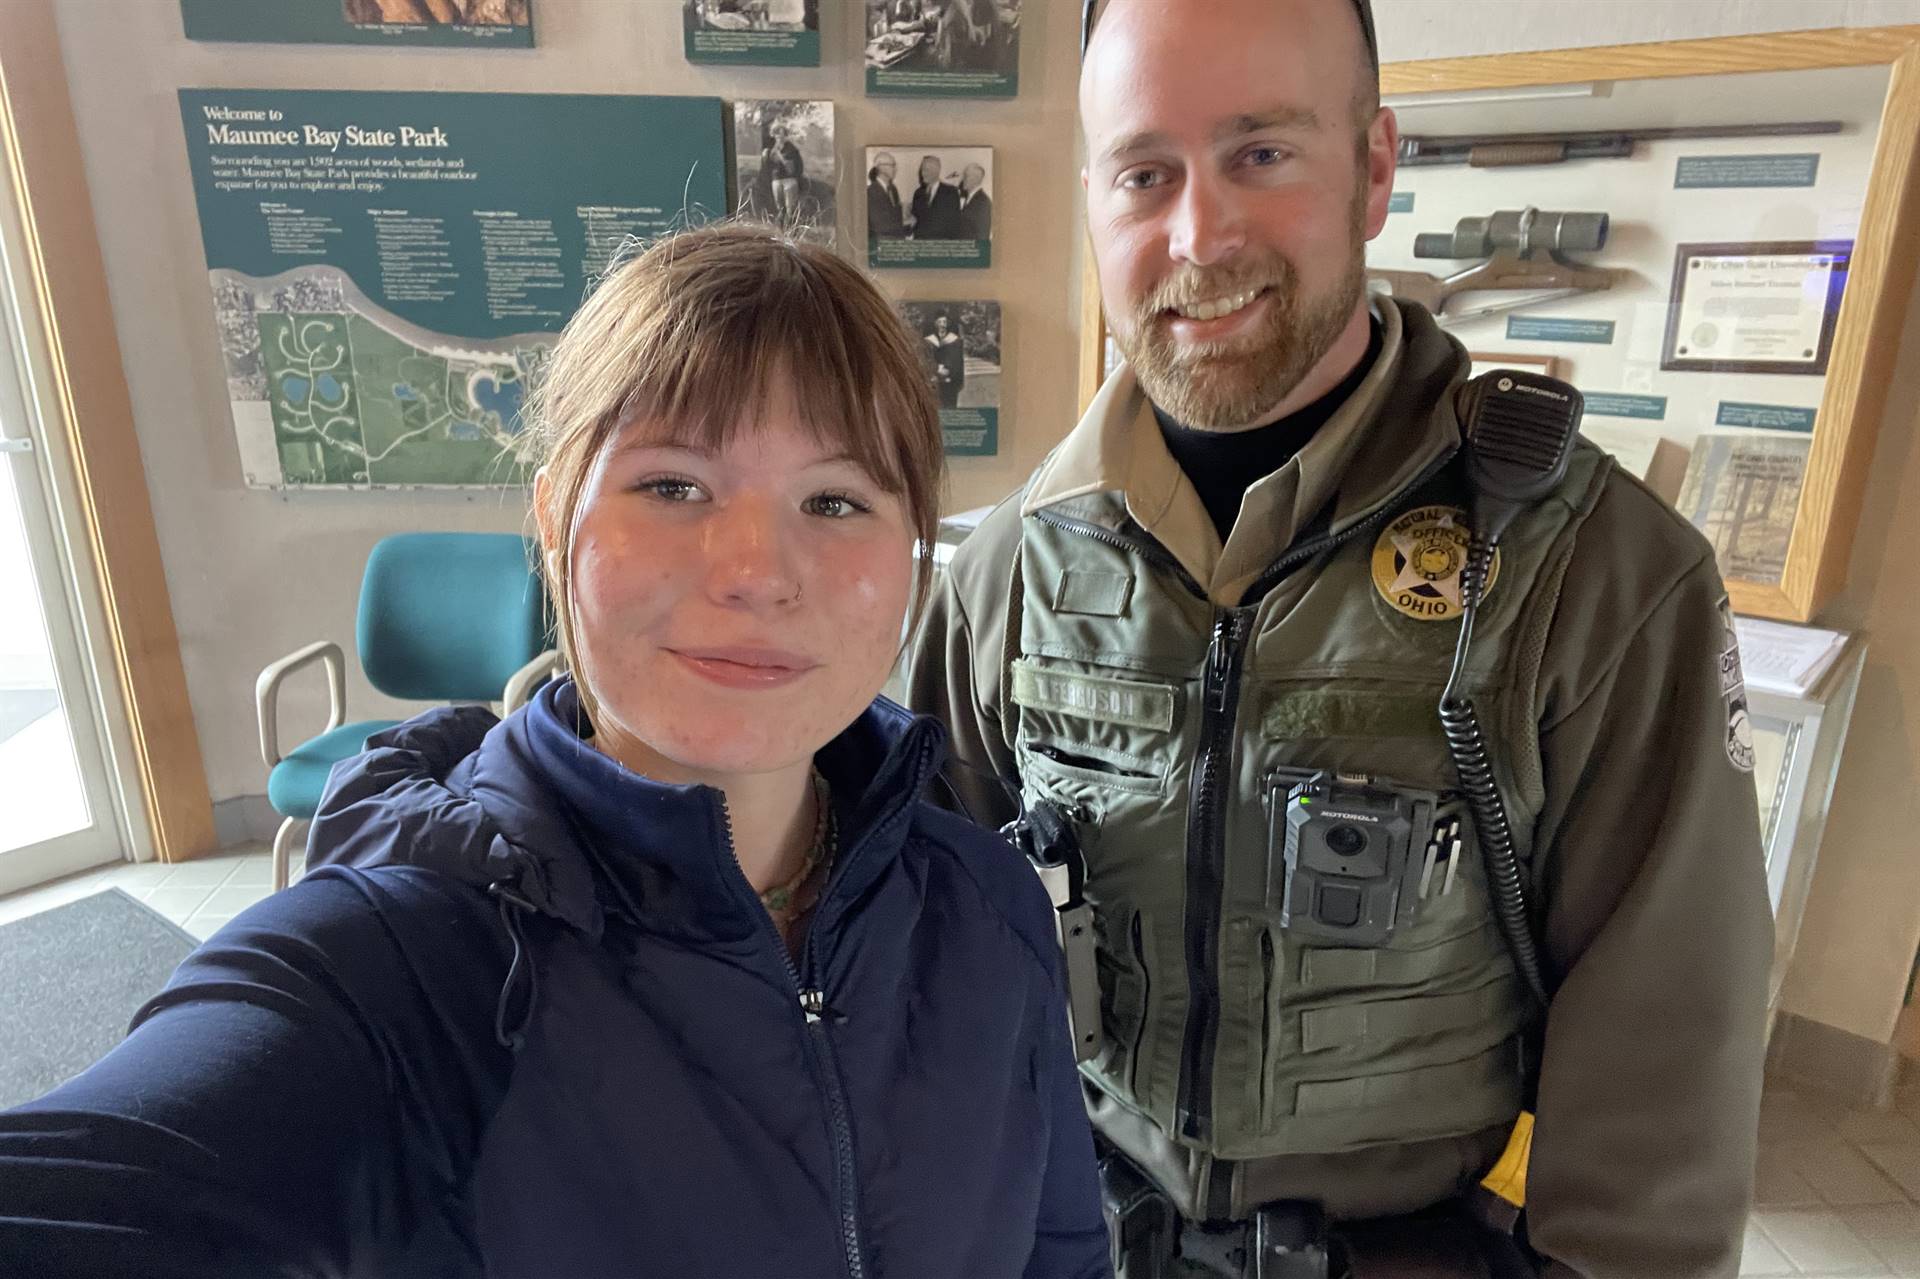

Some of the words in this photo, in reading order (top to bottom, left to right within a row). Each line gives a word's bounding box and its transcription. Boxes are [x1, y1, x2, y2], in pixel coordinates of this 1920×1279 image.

[203, 106, 266, 121] Welcome
[269, 109, 283, 121] to
[206, 124, 299, 145] Maumee
[302, 124, 341, 153] Bay
[345, 125, 396, 147] State
[399, 126, 448, 147] Park
[446, 158, 464, 169] and
[242, 167, 283, 178] Maumee
[284, 168, 302, 180] Bay
[328, 168, 349, 179] Park
[1515, 384, 1569, 402] MOTOROLA
[1398, 593, 1447, 615] OHIO
[1320, 810, 1379, 823] MOTOROLA
